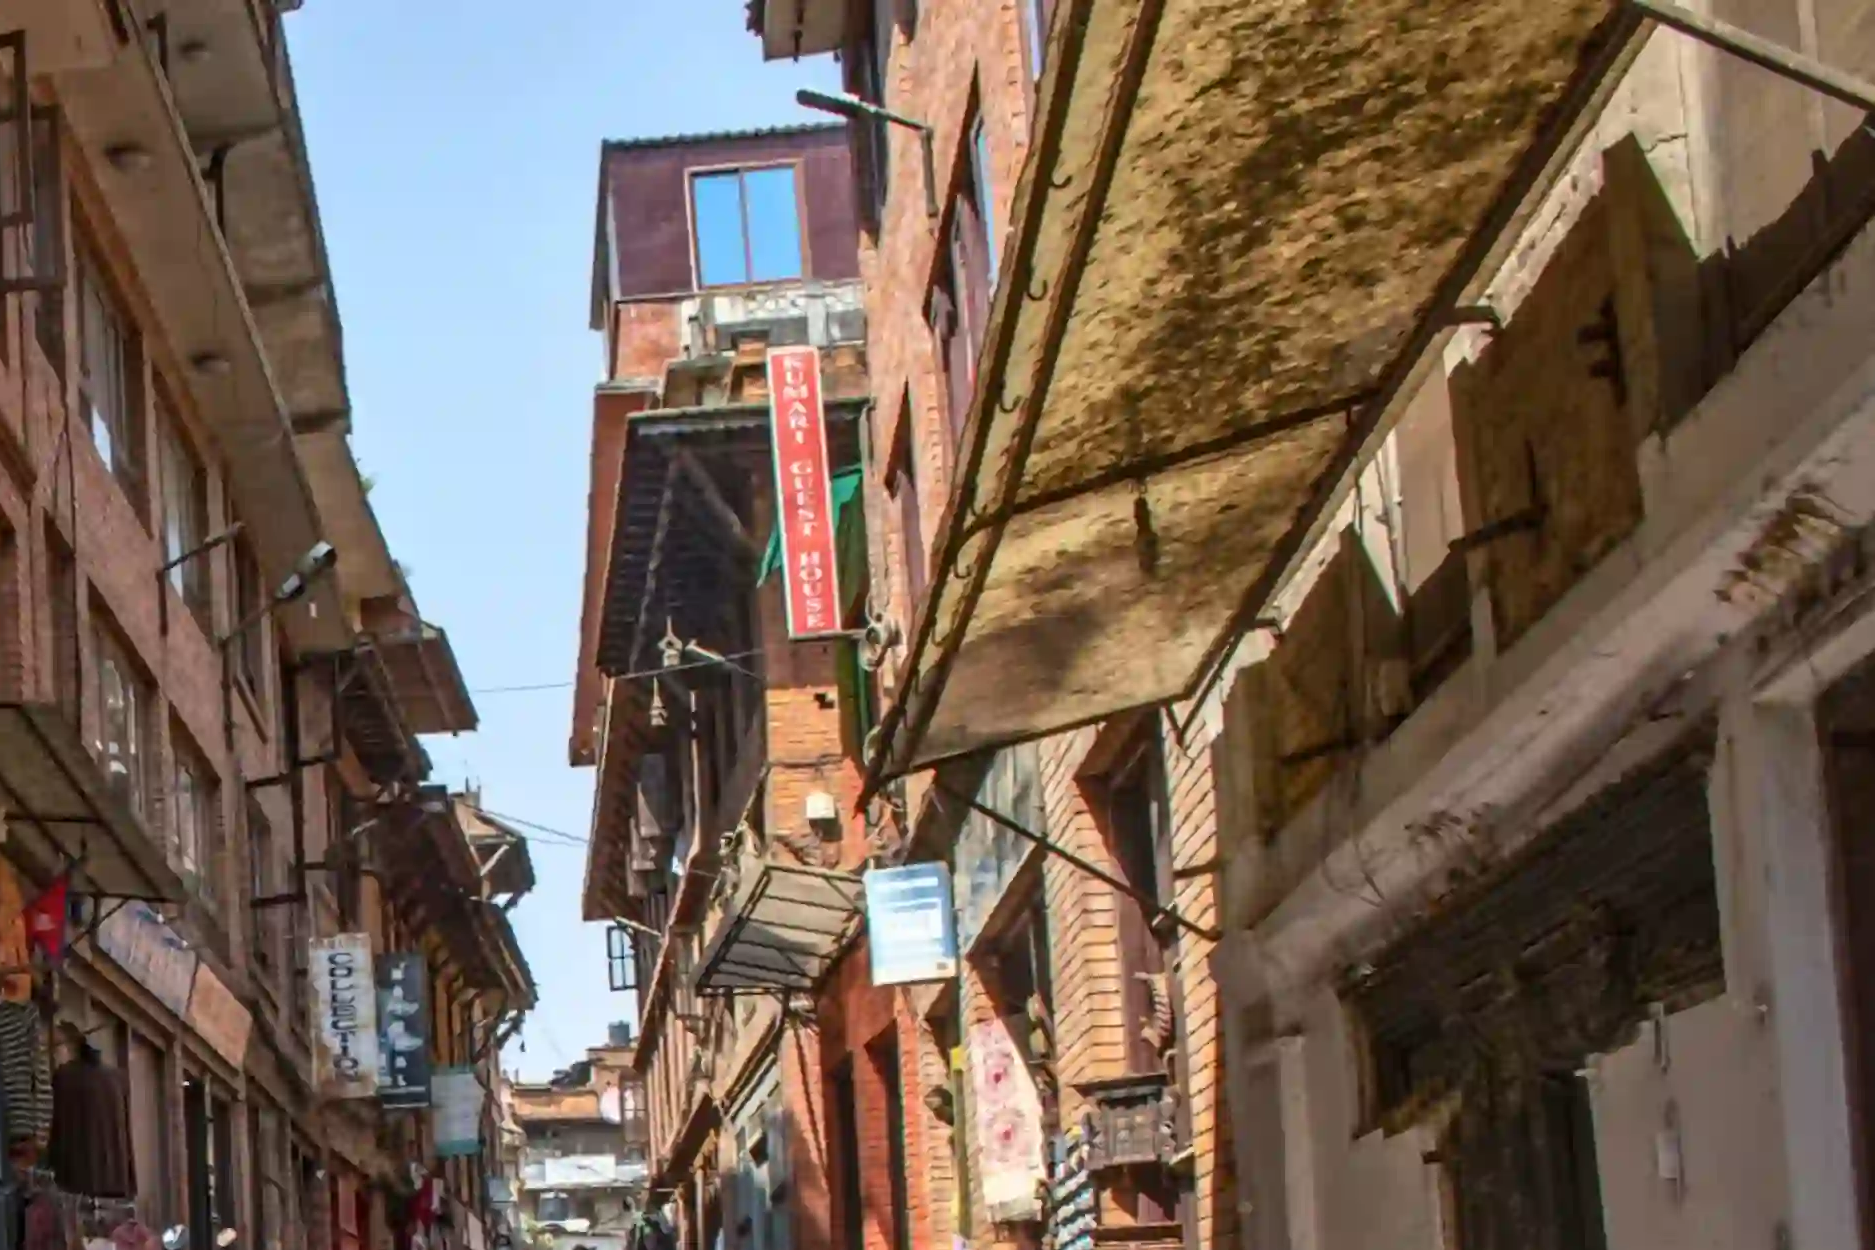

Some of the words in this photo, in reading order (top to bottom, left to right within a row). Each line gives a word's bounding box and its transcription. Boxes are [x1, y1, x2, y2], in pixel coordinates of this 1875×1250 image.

[782, 356, 810, 444] KUMARI
[789, 458, 819, 538] GUEST
[799, 551, 826, 629] HOUSE
